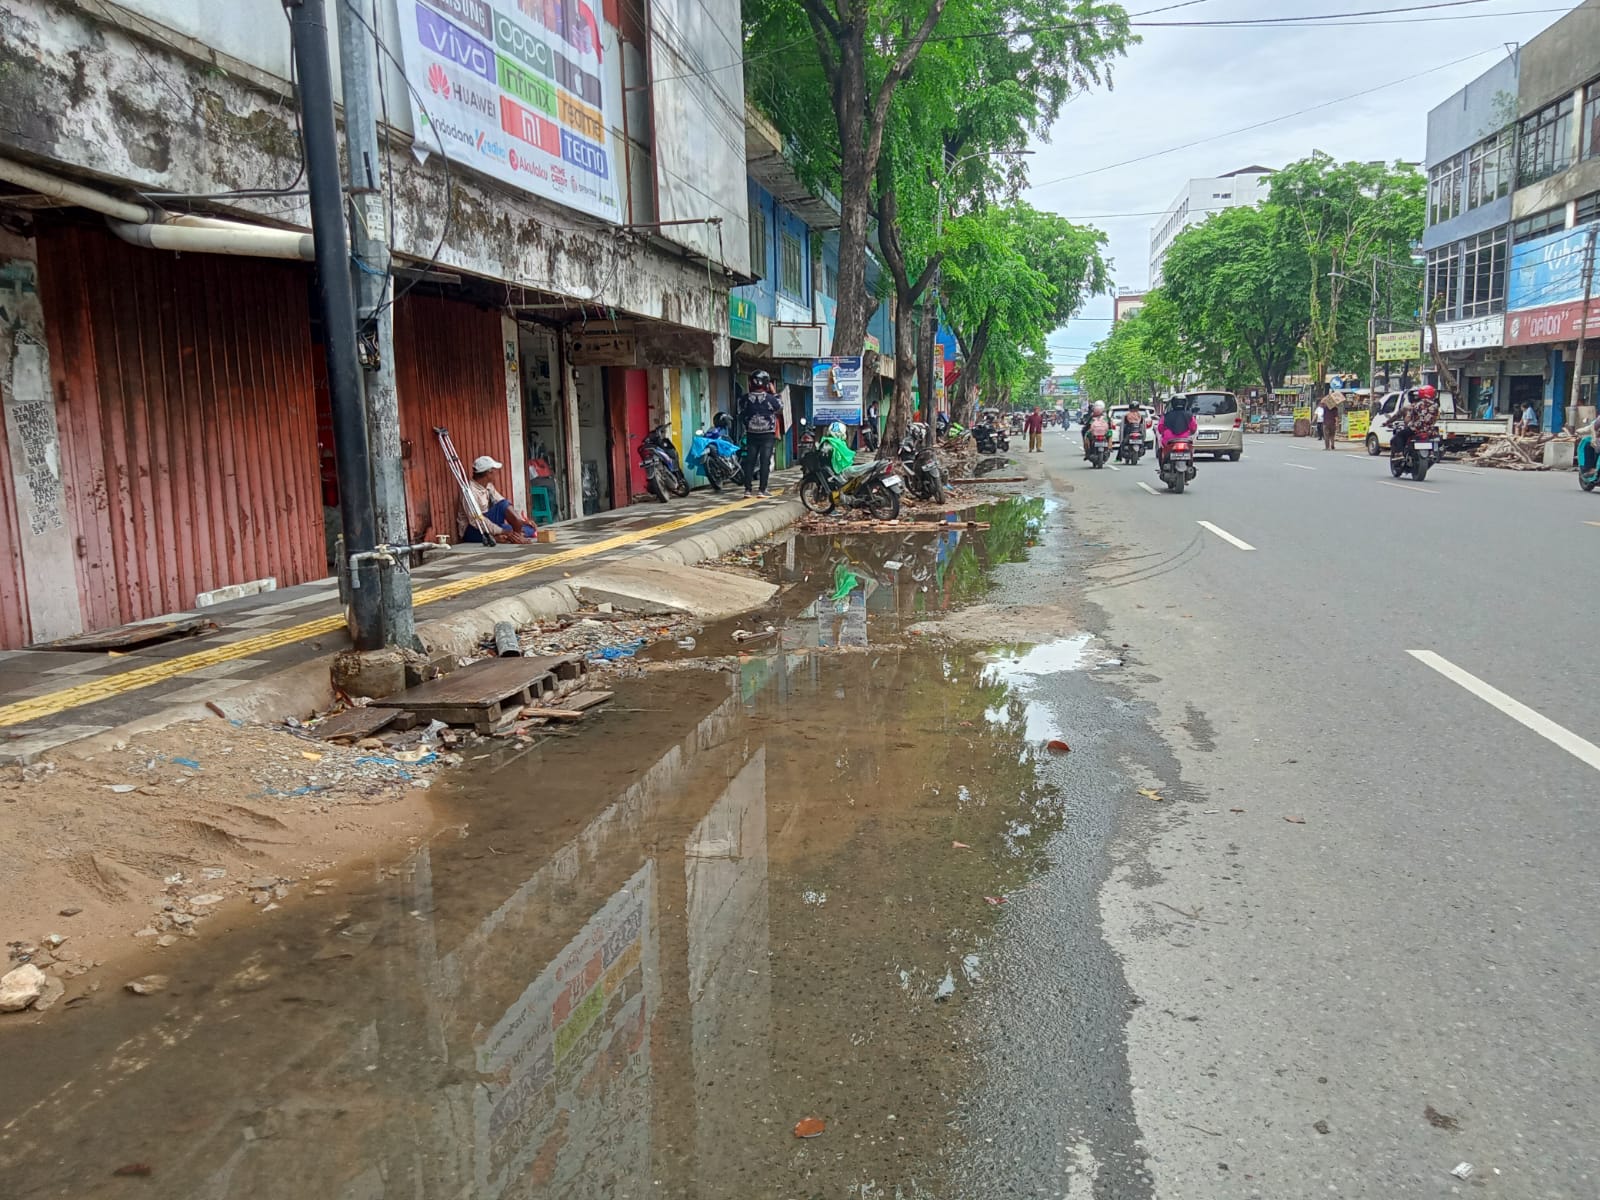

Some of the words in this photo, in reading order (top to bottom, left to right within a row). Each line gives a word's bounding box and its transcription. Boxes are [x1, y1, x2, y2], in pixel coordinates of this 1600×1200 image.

[429, 22, 487, 75] vivo
[498, 18, 547, 65] oppo
[452, 81, 496, 119] HUAWEI
[502, 61, 550, 111] Infinix
[563, 134, 605, 173] TECNO
[12, 402, 45, 416] SYARAF
